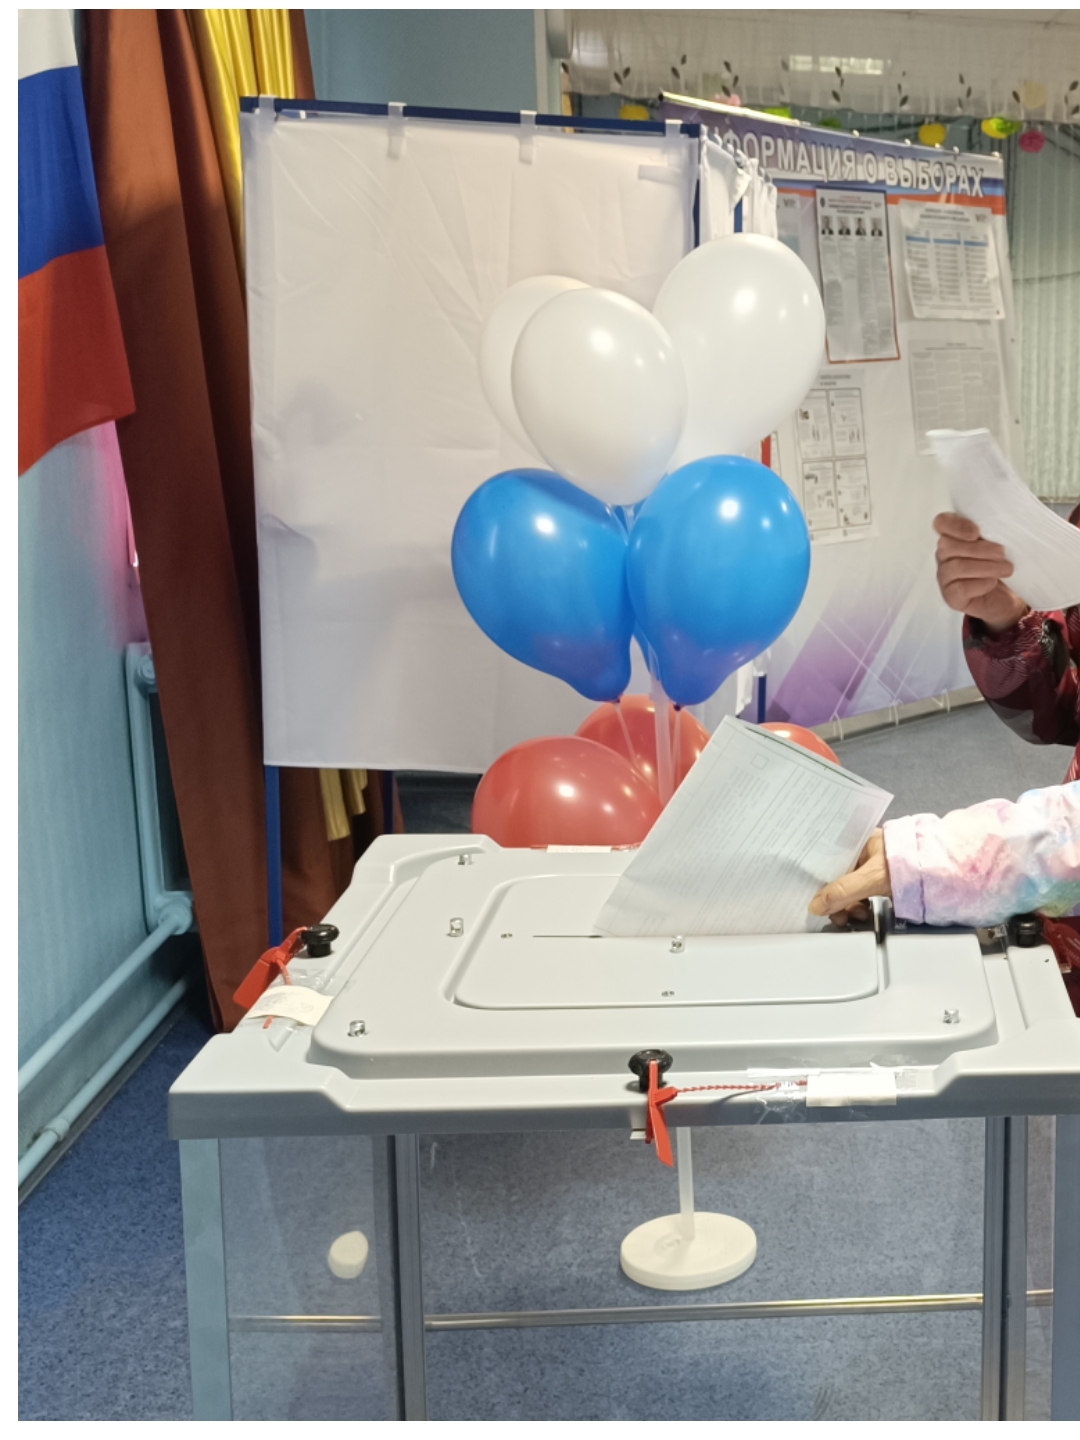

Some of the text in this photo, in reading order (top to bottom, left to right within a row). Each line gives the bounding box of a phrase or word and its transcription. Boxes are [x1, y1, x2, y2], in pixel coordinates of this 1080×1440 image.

[714, 127, 985, 198] ФОРМАЦИЯ О ВЫБОРАХ
